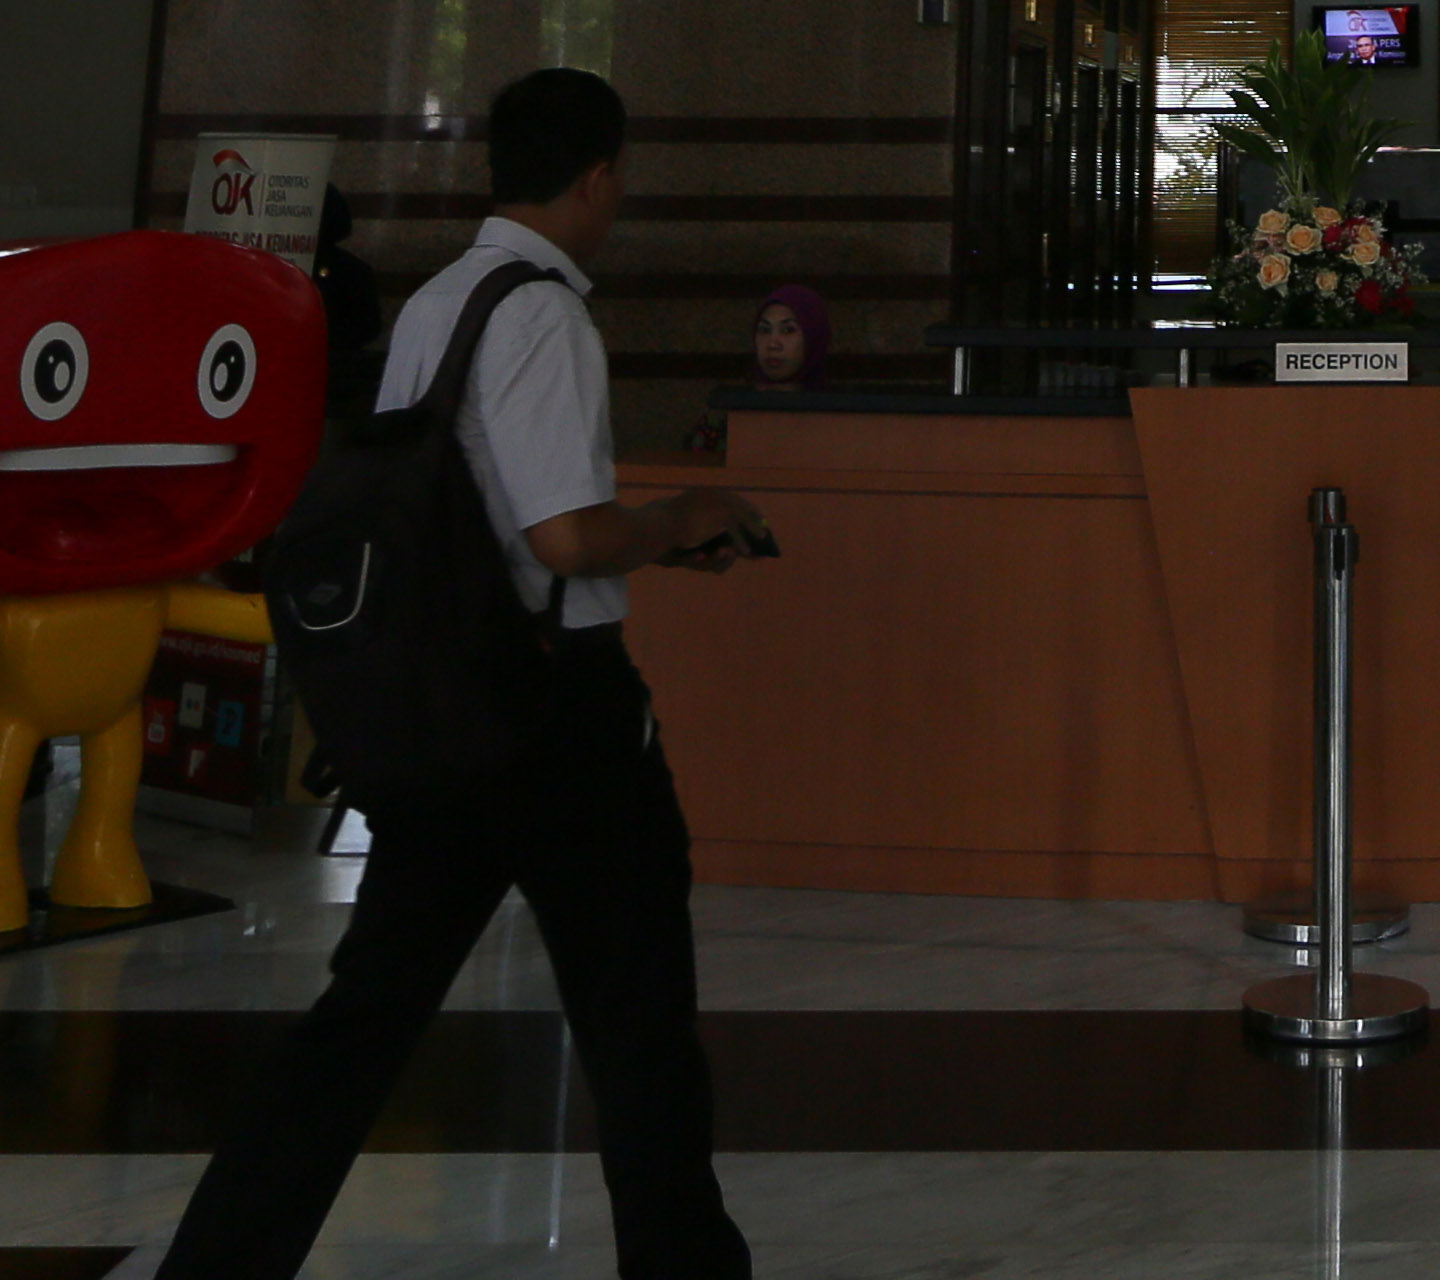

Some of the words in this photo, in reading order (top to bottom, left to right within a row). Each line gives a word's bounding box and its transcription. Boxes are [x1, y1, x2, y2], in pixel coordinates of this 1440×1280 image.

[1380, 39, 1400, 48] PERS
[268, 175, 309, 189] OTORITAS
[212, 173, 255, 215] OJK
[266, 190, 286, 202] JASA
[265, 205, 312, 217] KEUANGAN
[1286, 354, 1397, 369] RECEPTION
